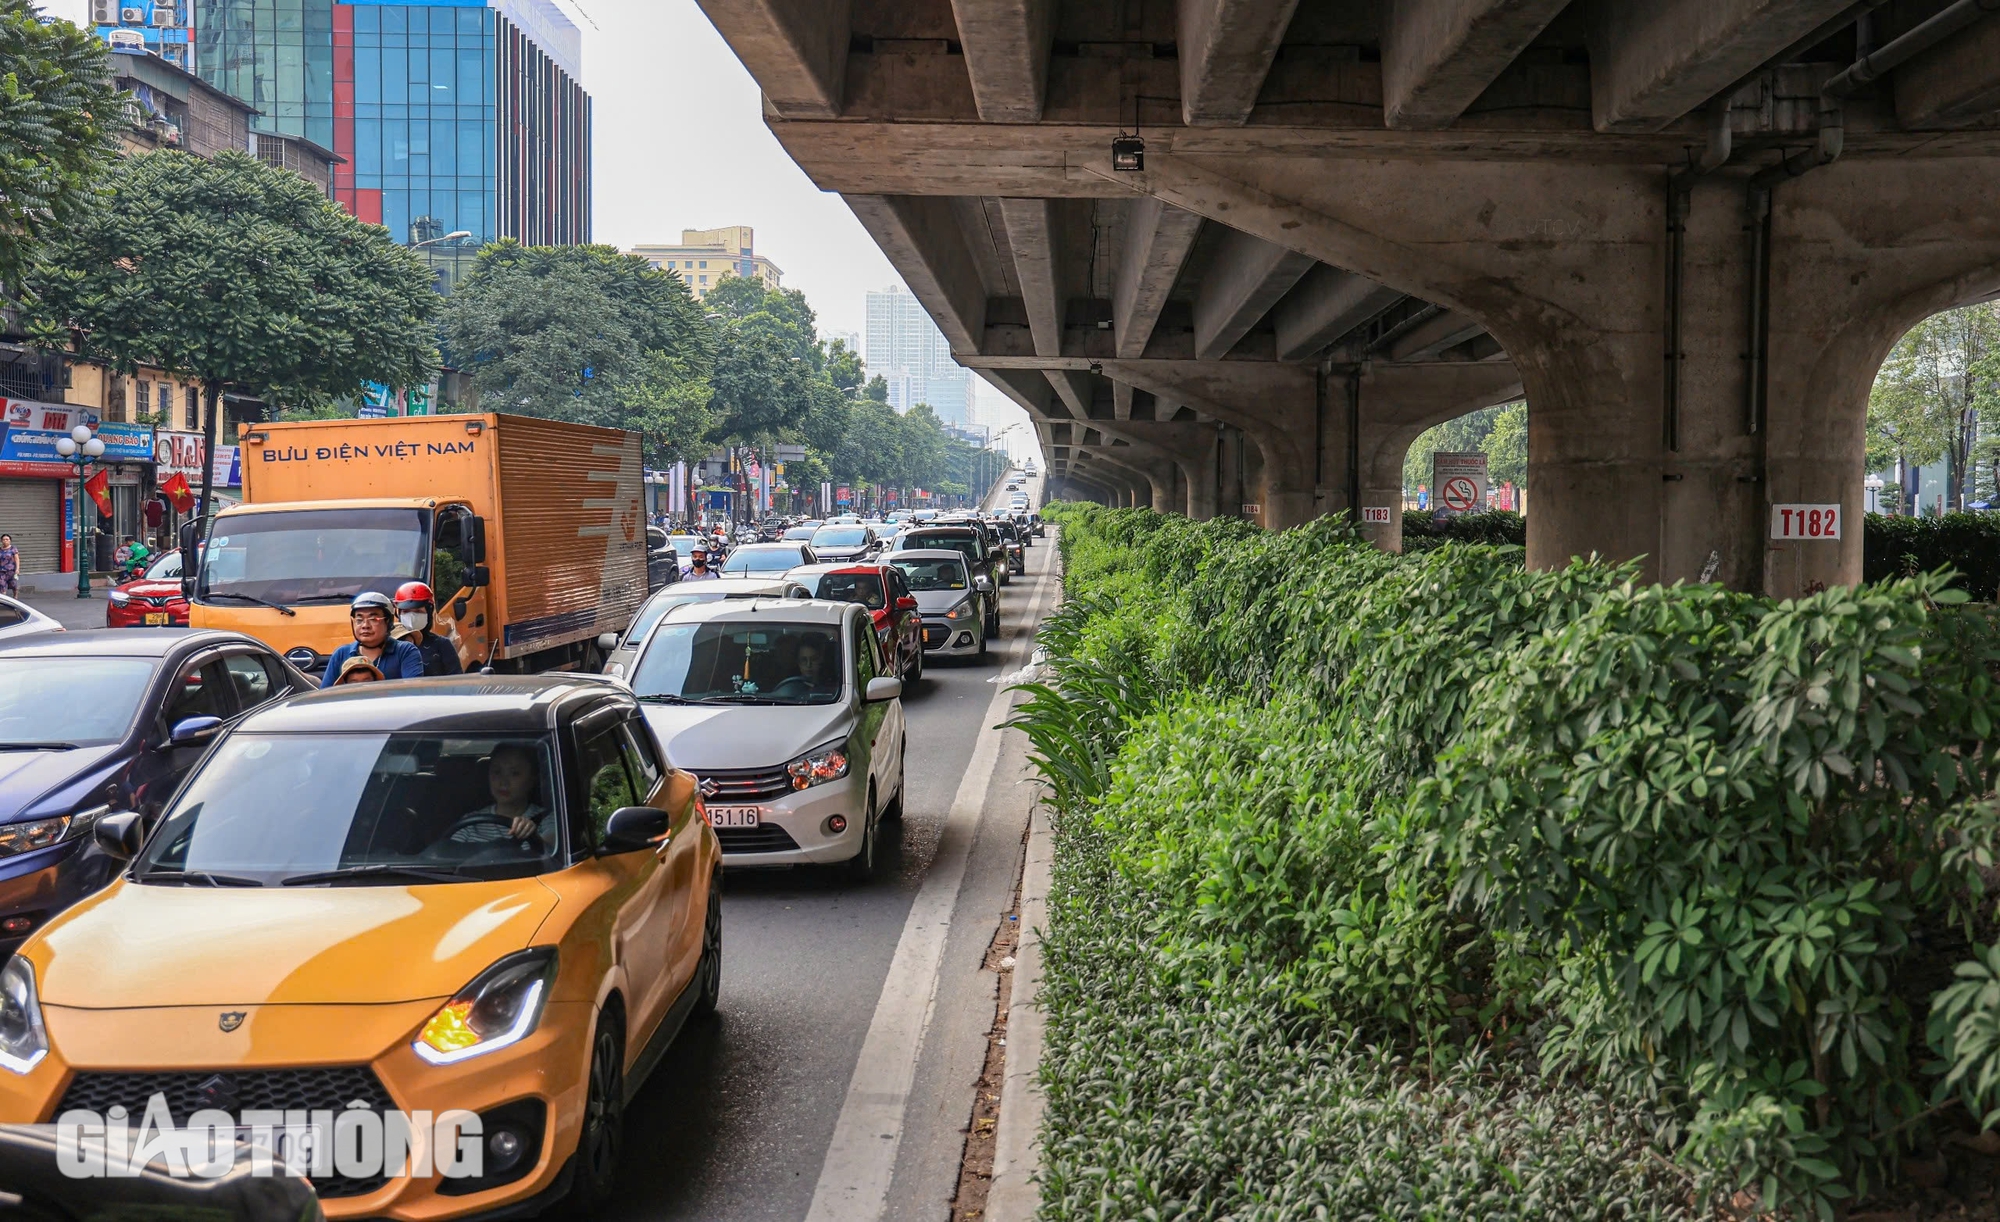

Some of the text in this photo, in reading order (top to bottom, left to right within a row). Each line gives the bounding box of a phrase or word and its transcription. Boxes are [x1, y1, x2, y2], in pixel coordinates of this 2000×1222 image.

[43, 412, 68, 430] DTH
[97, 433, 123, 445] QUANG
[263, 441, 474, 463] BƯU ĐIỆN VIỆT NAM
[1461, 457, 1478, 465] THUỐC
[1243, 505, 1259, 513] T184
[1364, 508, 1388, 521] T183
[1781, 509, 1836, 537] T182
